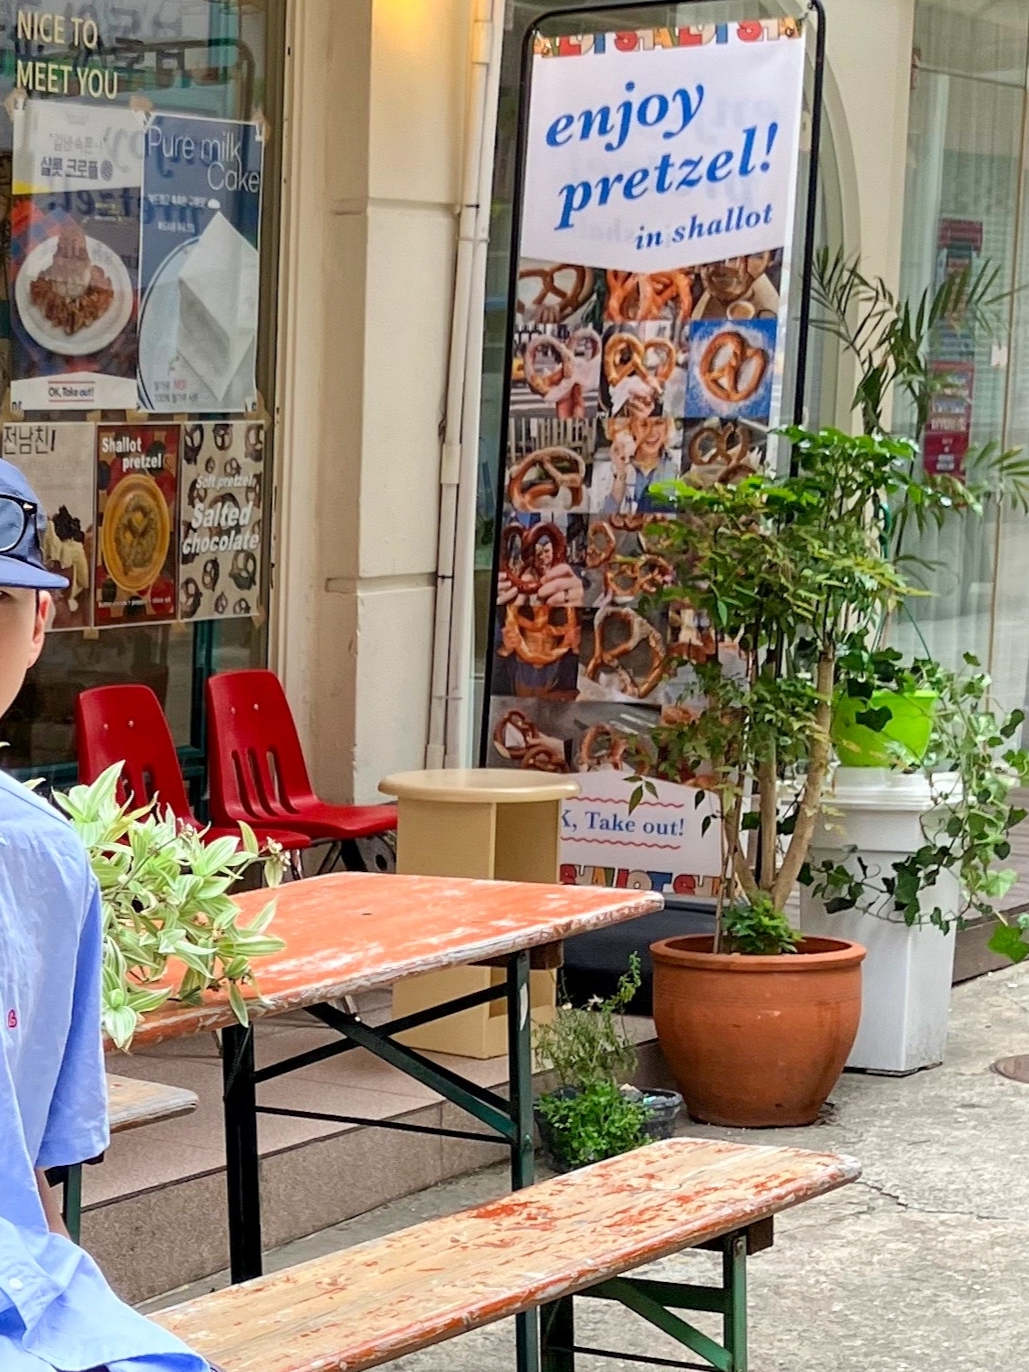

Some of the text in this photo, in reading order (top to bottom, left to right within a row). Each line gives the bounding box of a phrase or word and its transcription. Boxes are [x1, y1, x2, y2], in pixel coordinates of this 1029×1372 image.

[17, 10, 98, 49] NICE TO
[16, 59, 118, 100] MEET YOU
[545, 81, 705, 152] enjoy
[147, 125, 242, 163] Pure milk
[206, 161, 260, 193] Cake
[554, 121, 779, 232] pretzel!
[635, 203, 773, 250] in shallot
[101, 437, 142, 453] Shallot
[122, 453, 163, 472] pretzel
[191, 501, 253, 529] Salted
[182, 530, 260, 555] chocolate
[584, 811, 636, 833] Take
[642, 818, 685, 837] out!
